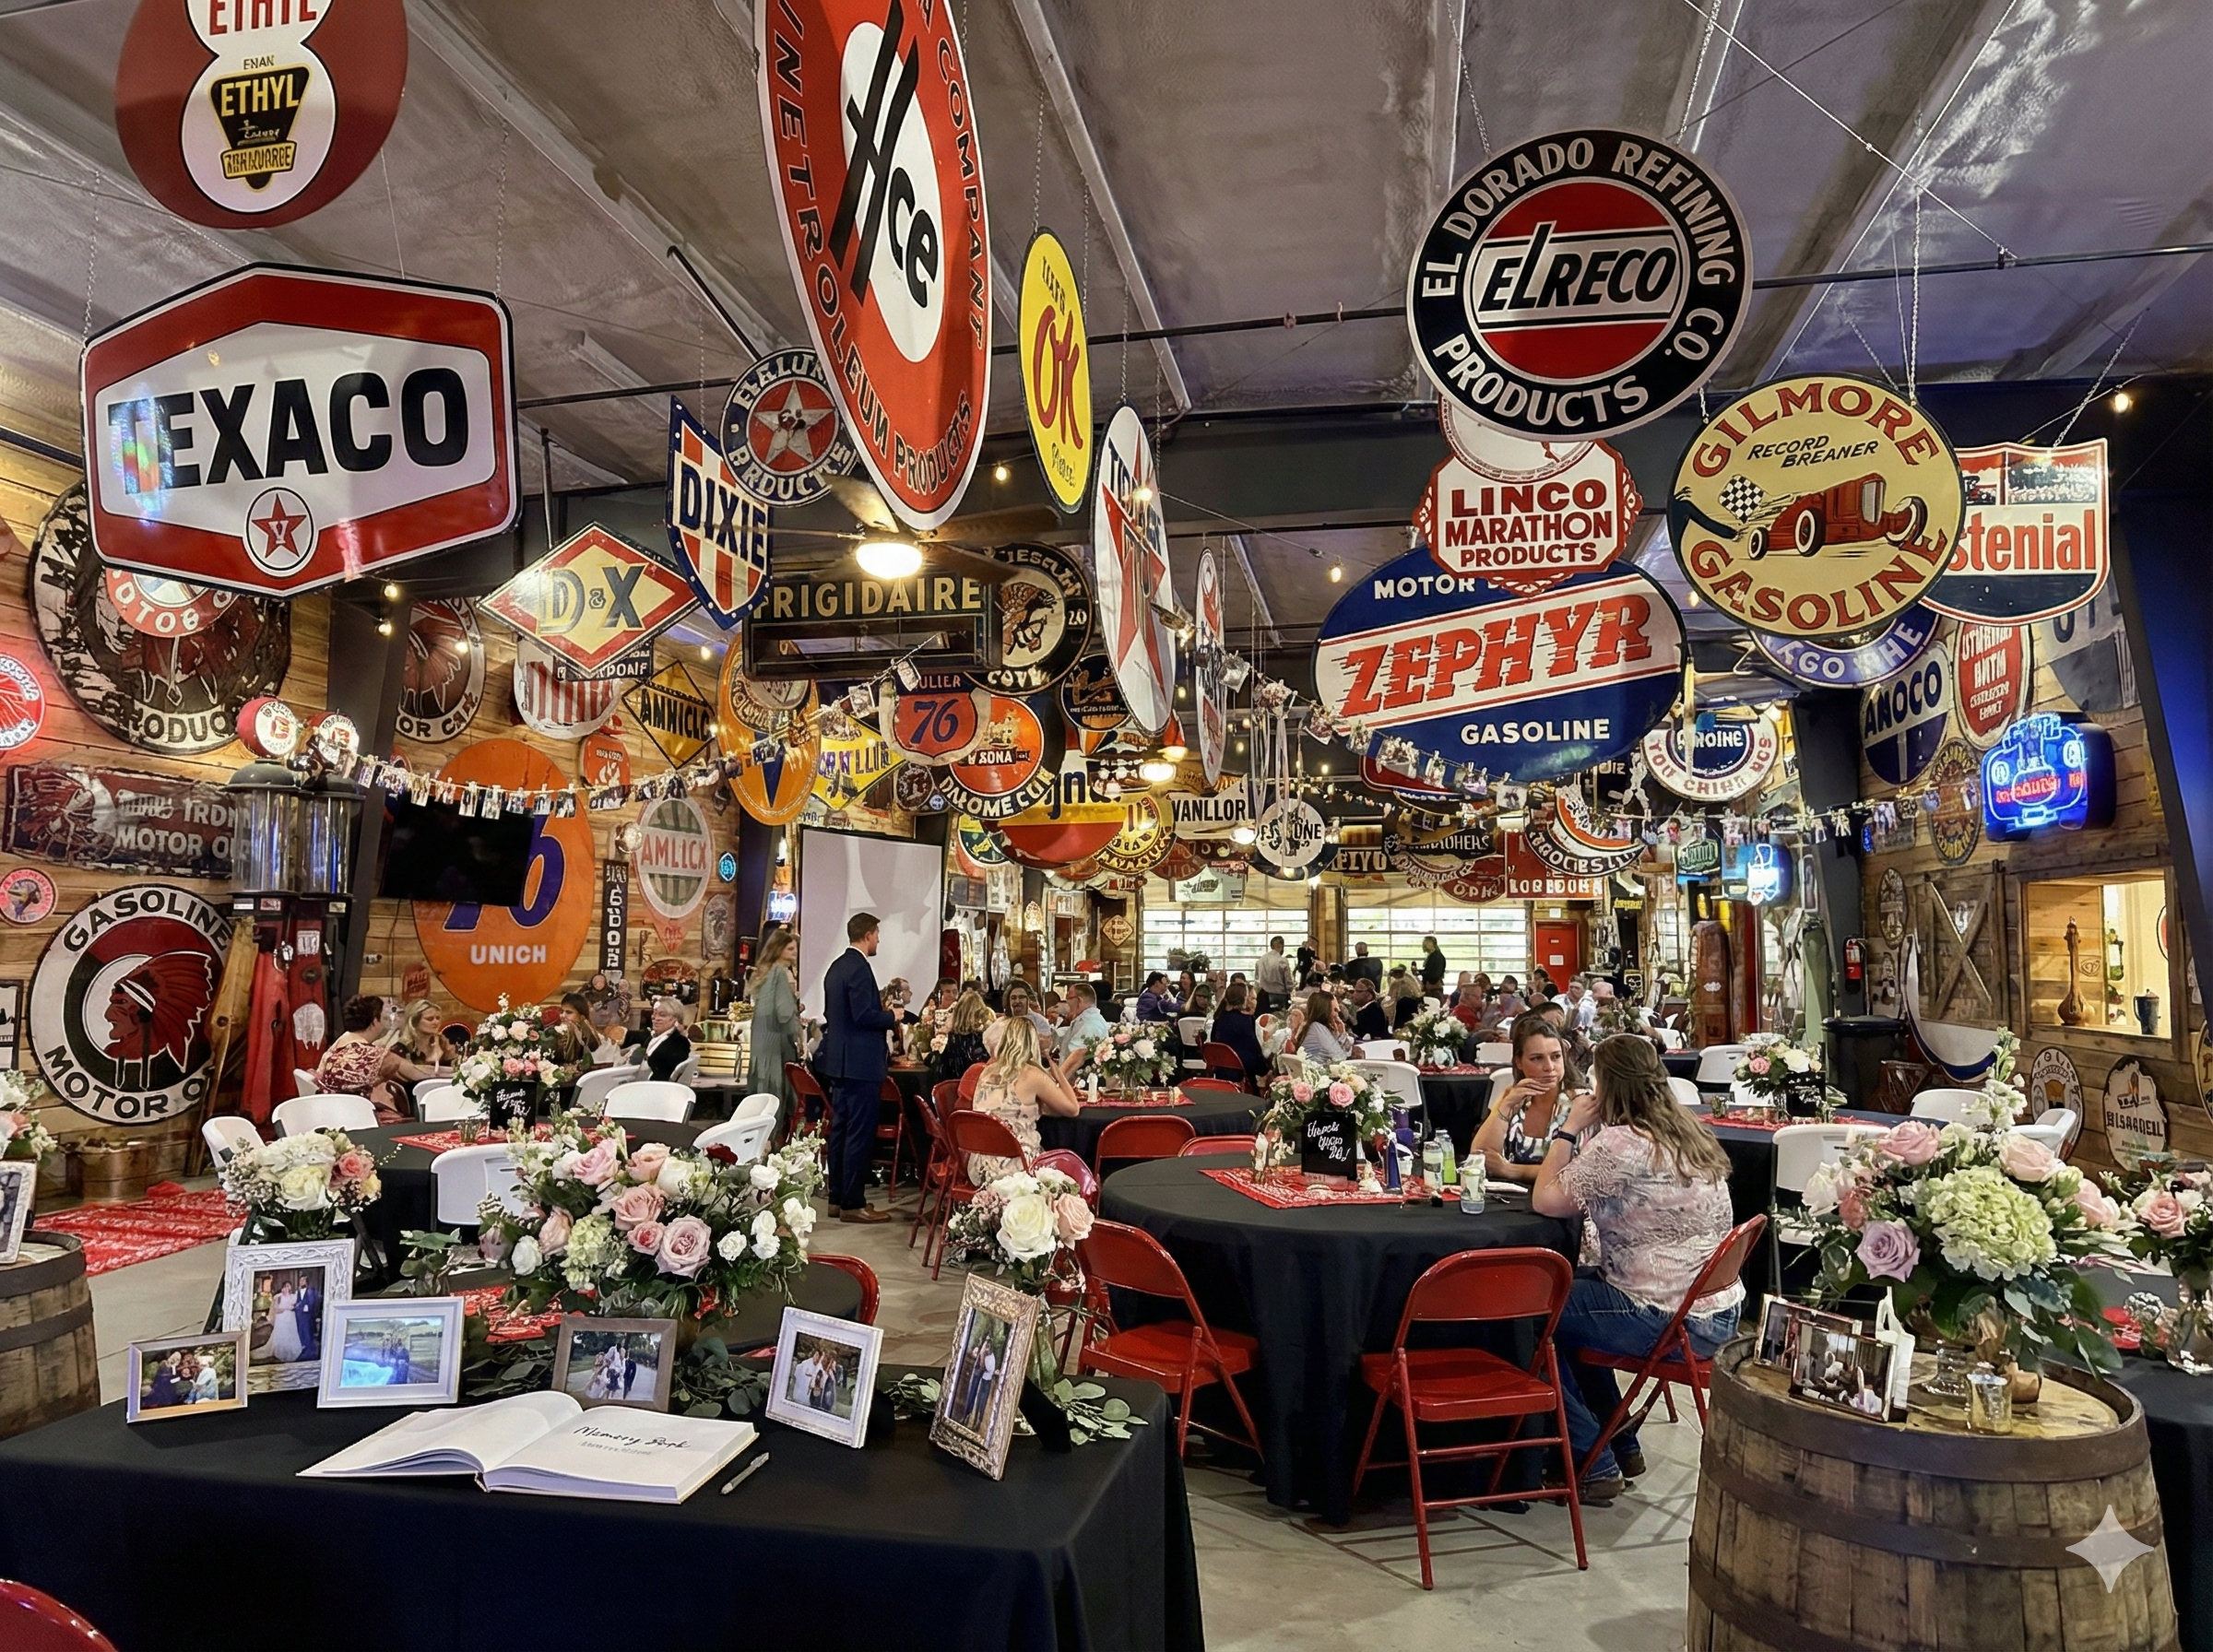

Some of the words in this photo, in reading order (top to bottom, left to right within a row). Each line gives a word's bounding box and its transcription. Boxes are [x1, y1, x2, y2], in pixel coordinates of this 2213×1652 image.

[221, 74, 300, 117] ETHYL
[1422, 253, 1462, 298] EL
[1442, 137, 1594, 240] DORADO
[1612, 140, 1735, 285] REFINING
[1477, 221, 1677, 312] ELRECO
[1033, 304, 1083, 450] OK
[1432, 333, 1649, 427] PRODUCTS
[107, 368, 468, 495] TEXACO
[1692, 383, 1940, 478] GILMORE
[1747, 435, 1829, 461] RECORD
[680, 460, 767, 572] DIXIE
[1445, 512, 1613, 548] MARATHON
[1451, 478, 1607, 517] LINCO
[1375, 573, 1475, 599] MOTOR
[1461, 543, 1597, 568] PRODUCTS
[1690, 526, 1948, 631] GASOLINE
[1334, 595, 1652, 718] ZEPHYR
[910, 699, 959, 744] 76
[1461, 718, 1612, 746] GASOLINE
[115, 825, 203, 857] MOTOR
[64, 889, 234, 952] GASOLINE
[44, 1044, 169, 1118] MOTOR
